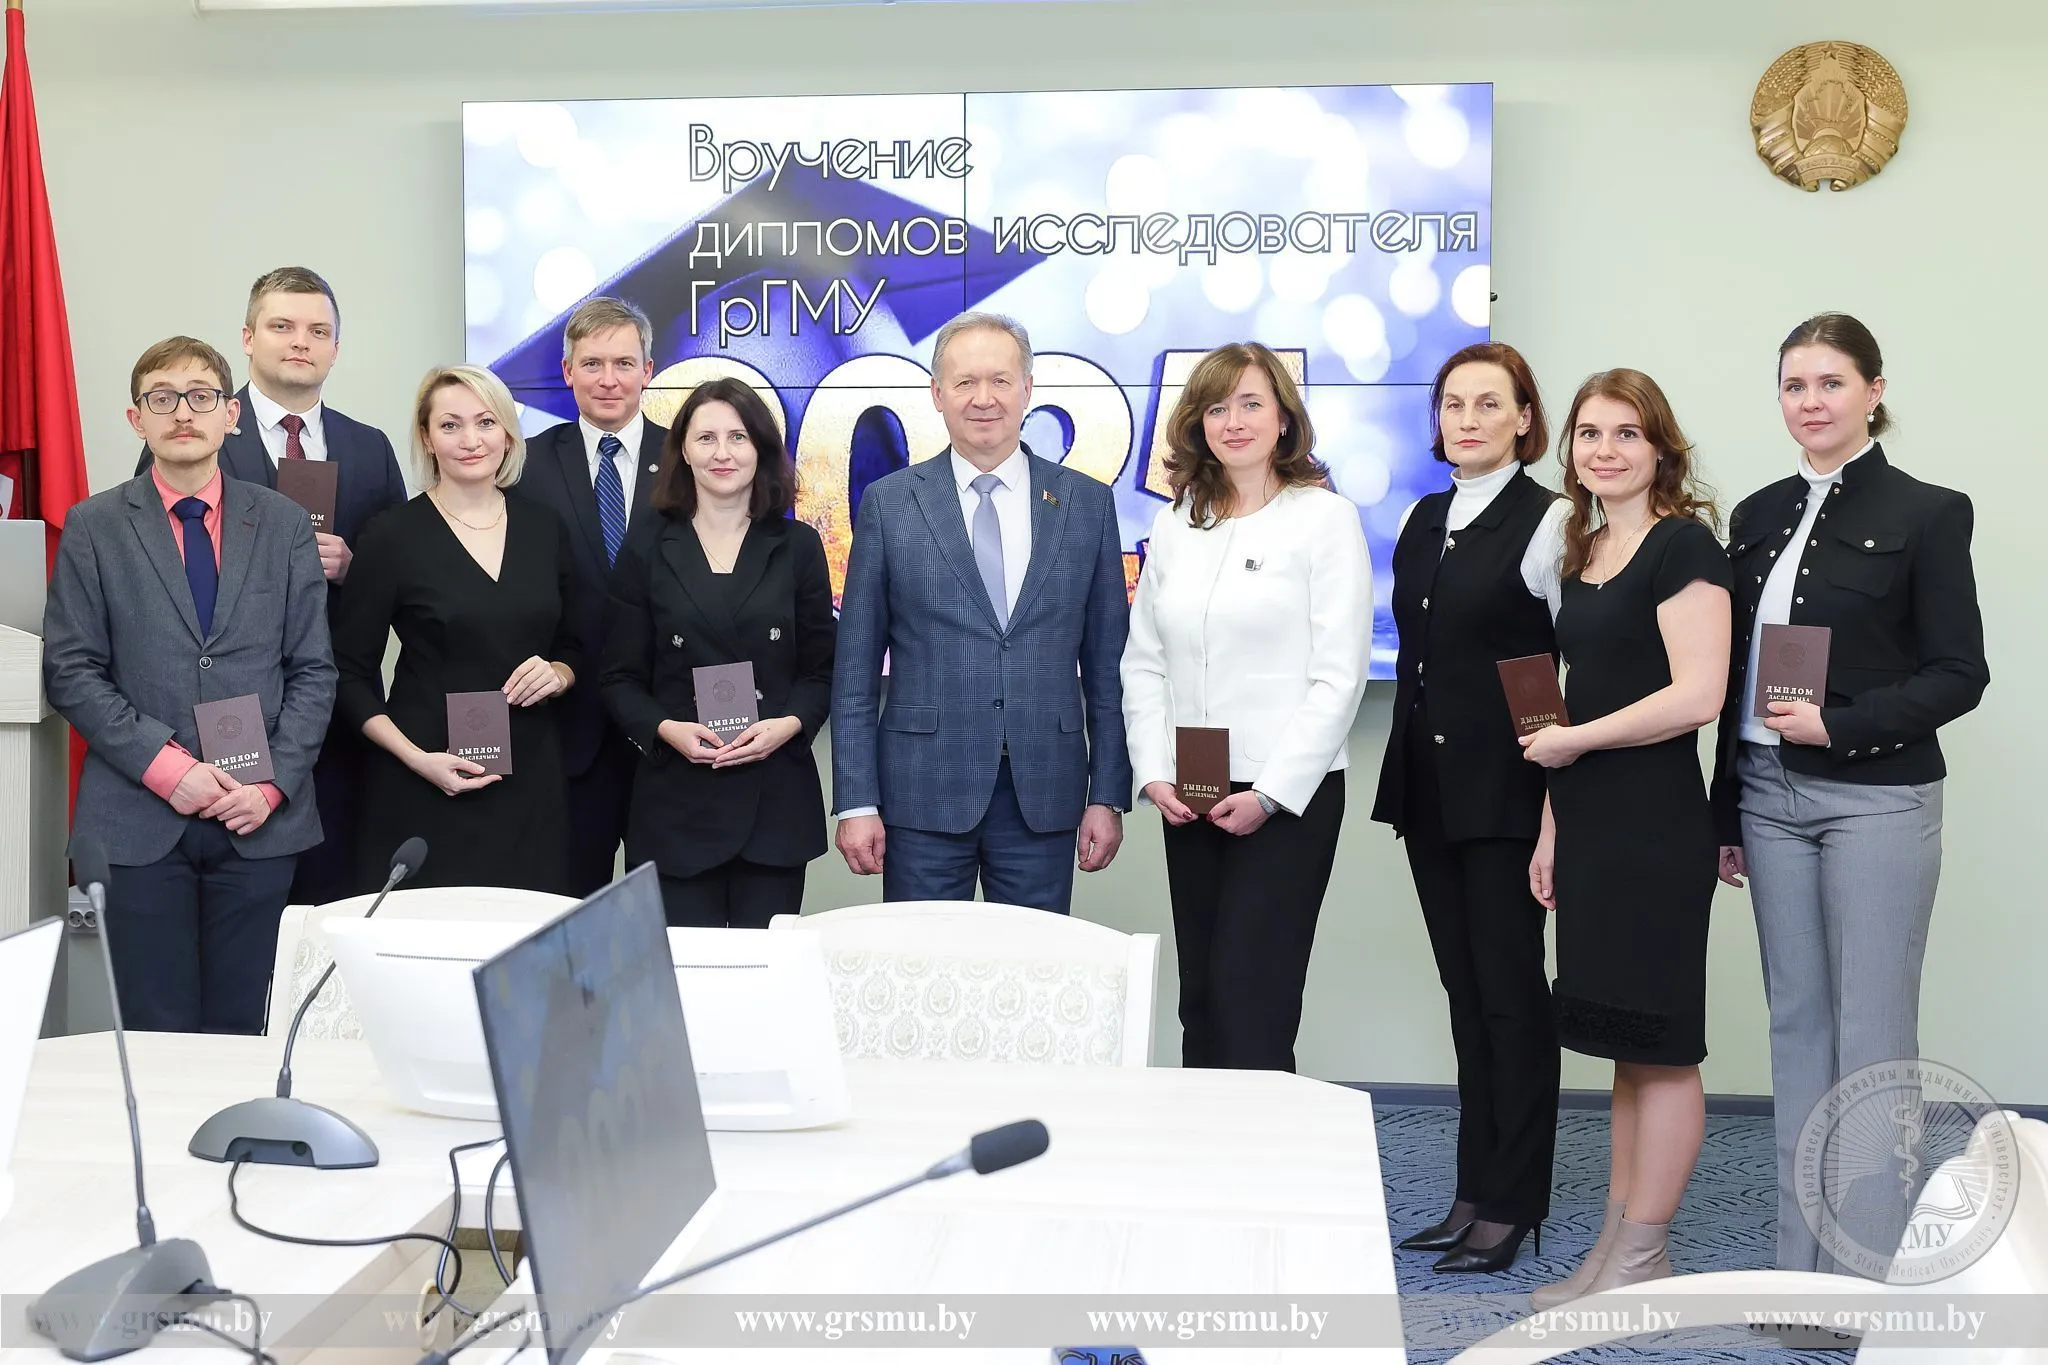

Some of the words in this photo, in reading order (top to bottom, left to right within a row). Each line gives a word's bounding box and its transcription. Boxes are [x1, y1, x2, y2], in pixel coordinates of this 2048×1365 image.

[688, 123, 975, 194] Вручение
[688, 215, 968, 269] дипломов
[993, 210, 1479, 266] исследователя
[688, 277, 888, 349] ГрГМУ
[1766, 685, 1813, 696] ДЫПЛОМ
[708, 716, 749, 728] ДЫПЛОМ
[1520, 713, 1558, 725] ДЫПЛОМ
[458, 746, 501, 756] ДЫПЛОМ
[214, 751, 260, 767] ДЫПЛОМ
[220, 760, 259, 772] АСЛЕДЧЫКА
[1182, 783, 1220, 793] ДЫПЛОМ
